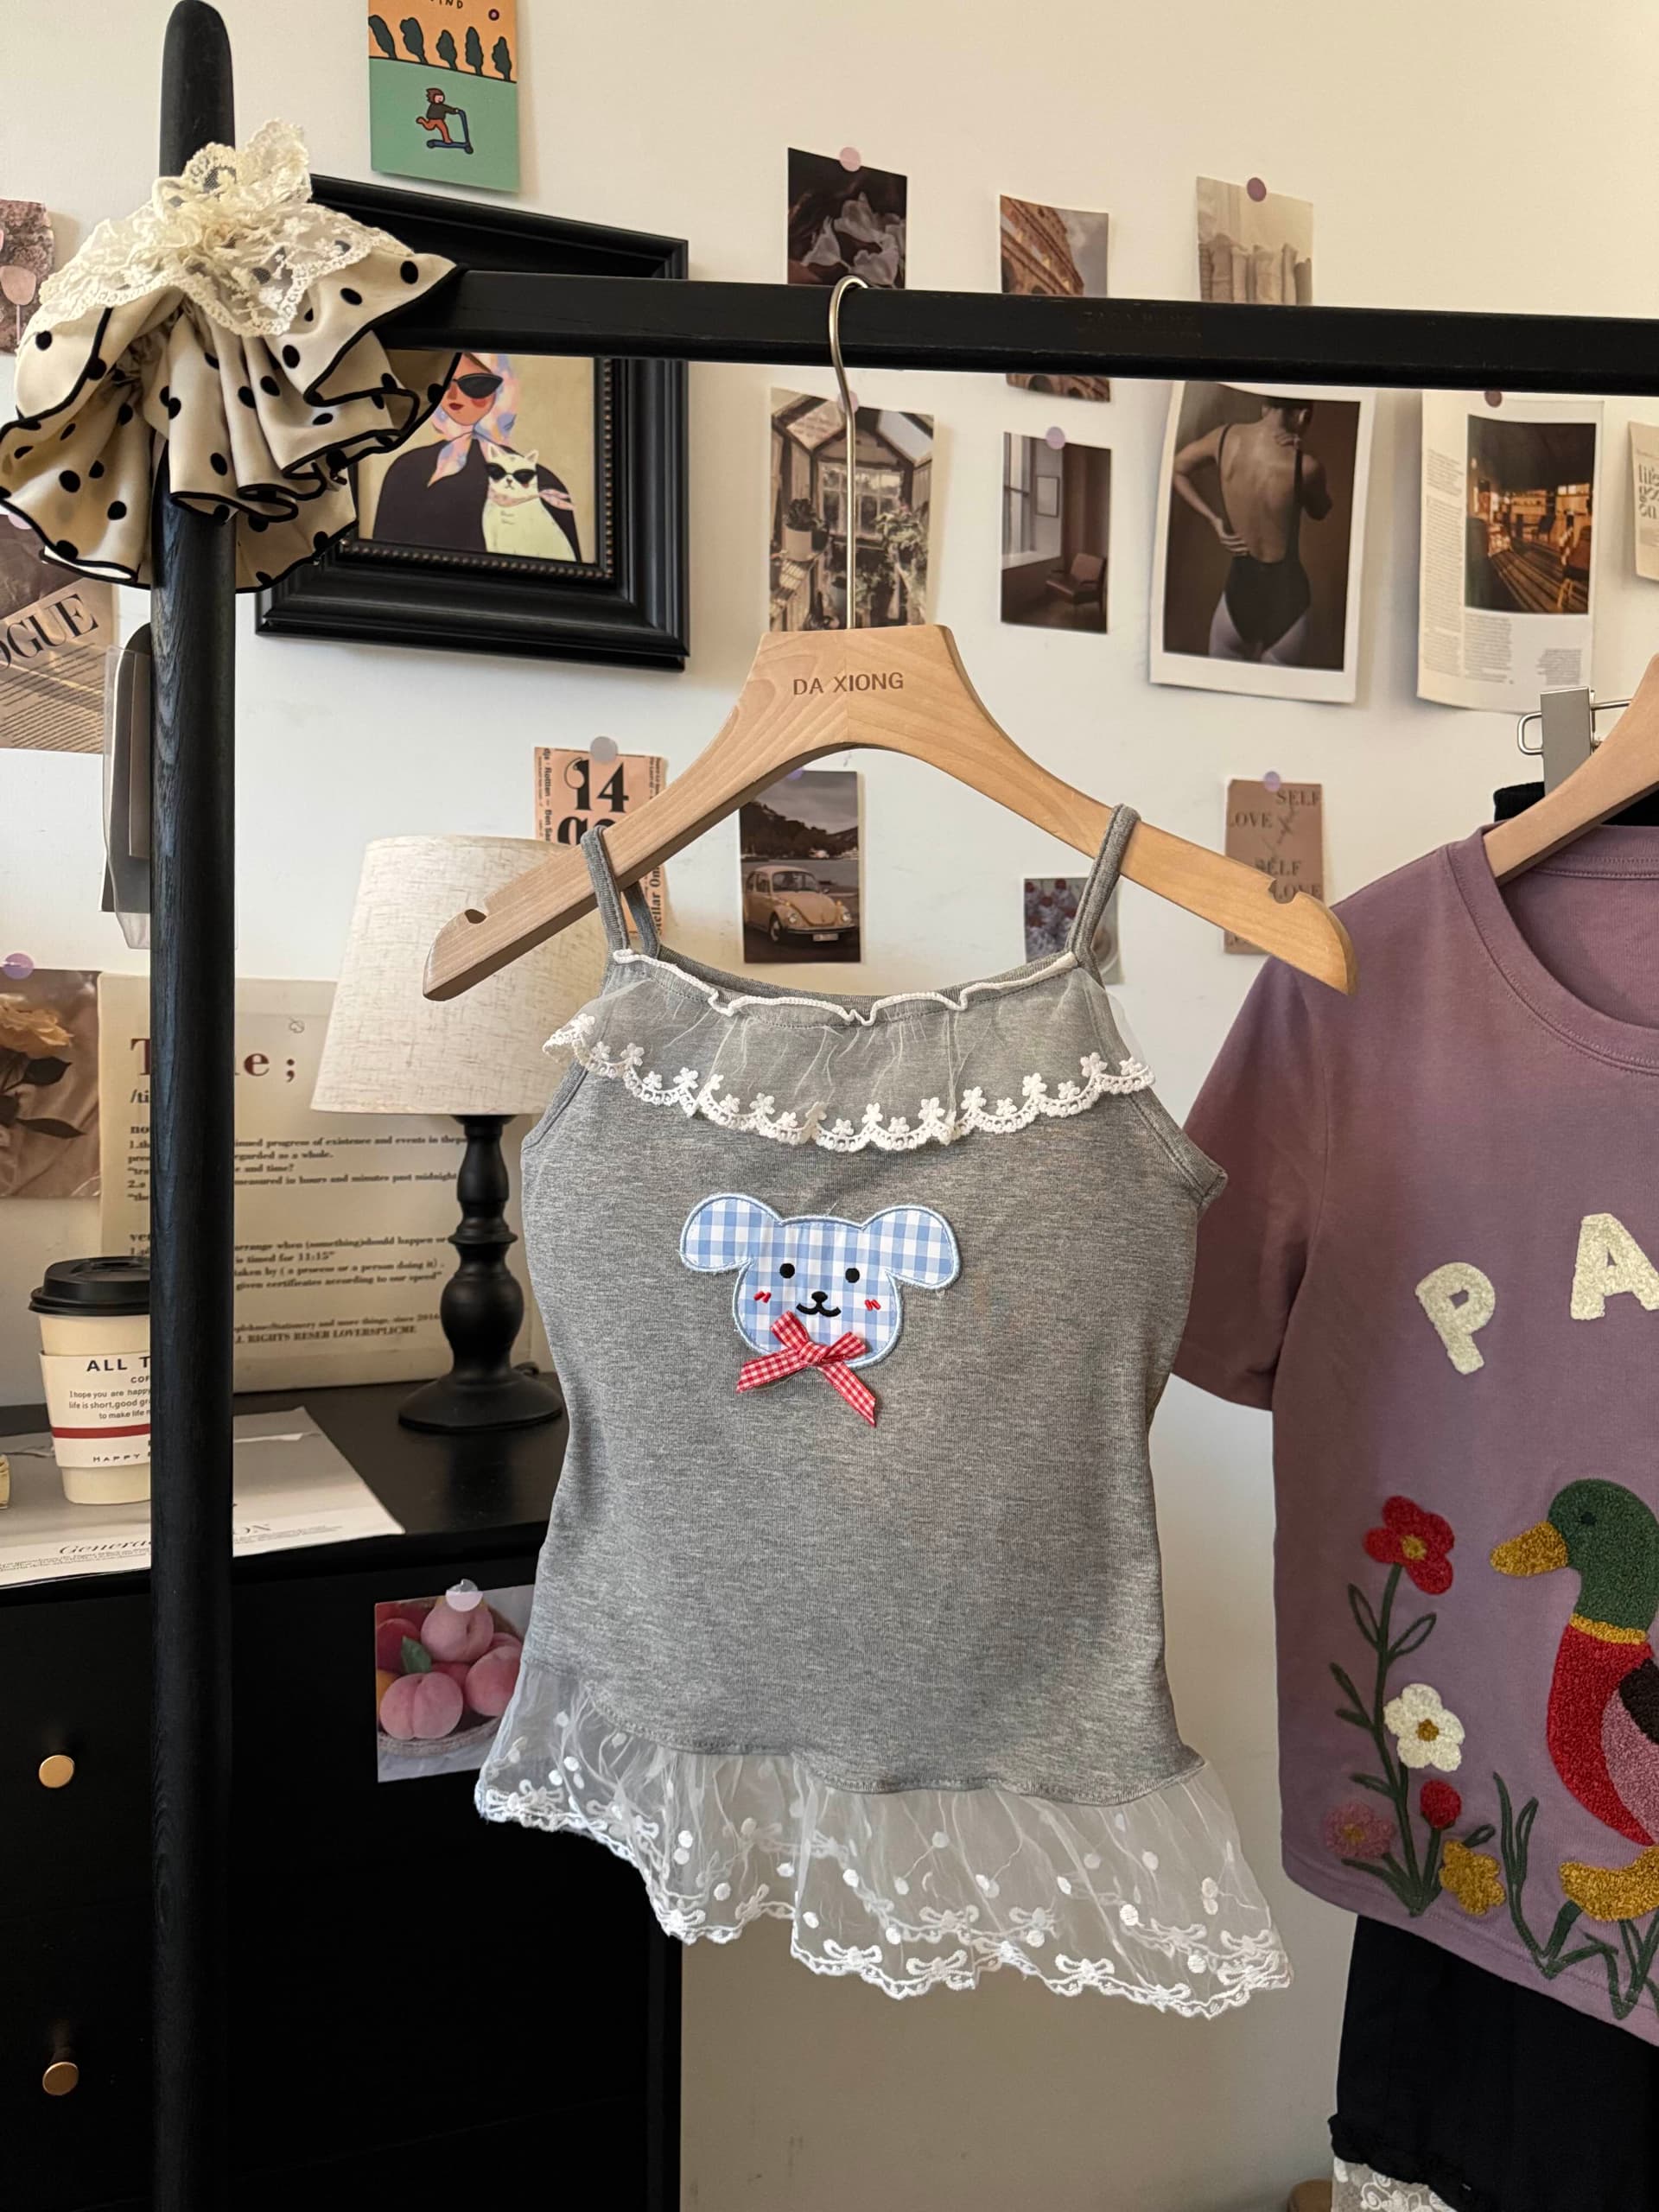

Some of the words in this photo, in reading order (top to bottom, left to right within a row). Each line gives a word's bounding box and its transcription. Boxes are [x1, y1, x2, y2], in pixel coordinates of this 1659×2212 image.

[793, 677, 823, 695] DA
[833, 672, 904, 692] XIONG
[564, 757, 629, 813] 14
[374, 1135, 393, 1145] and
[330, 1174, 348, 1184] and
[86, 1358, 128, 1372] ALL
[69, 1401, 80, 1409] life
[92, 1452, 140, 1463] HAPPY
